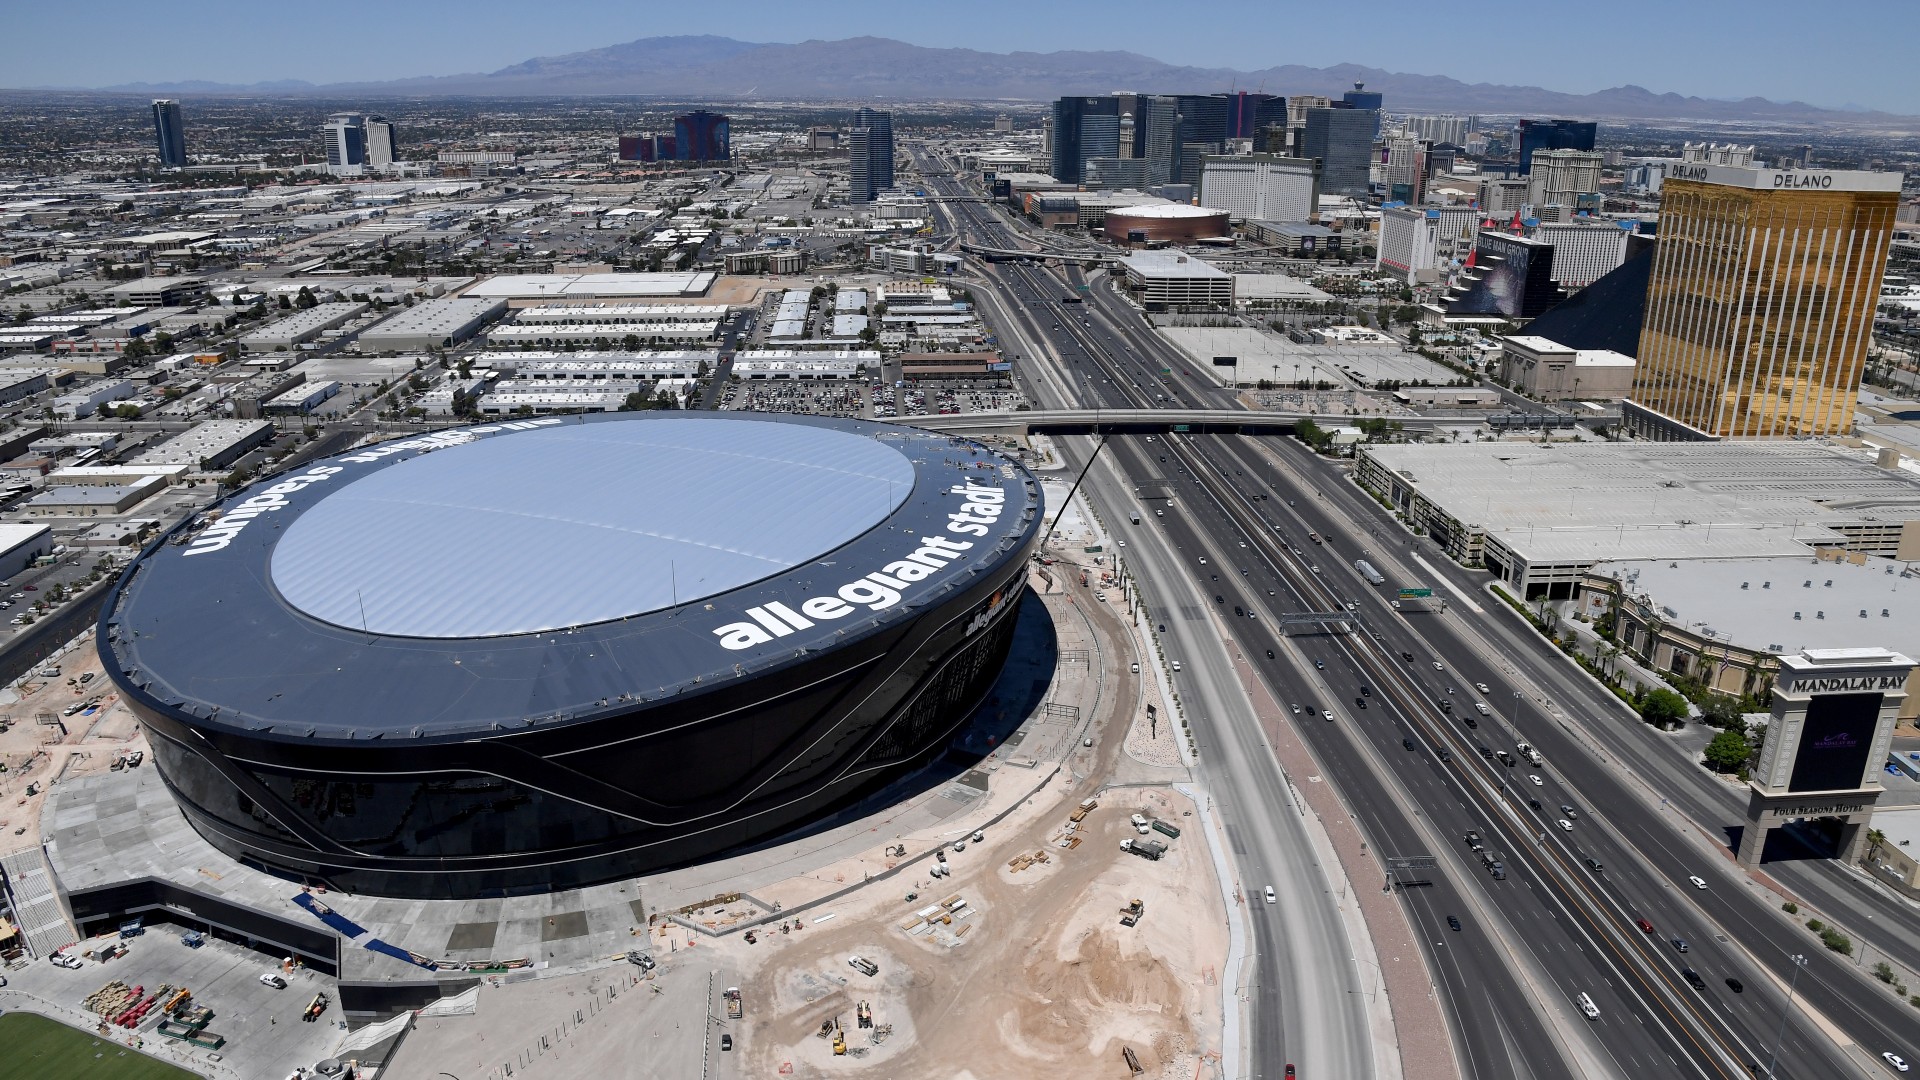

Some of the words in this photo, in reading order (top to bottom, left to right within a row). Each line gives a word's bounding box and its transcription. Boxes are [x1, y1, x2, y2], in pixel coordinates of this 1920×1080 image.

[1672, 164, 1708, 180] DELANO
[1773, 173, 1832, 188] DELANO
[1477, 236, 1493, 250] BLUE
[1492, 239, 1507, 254] MAN
[1506, 243, 1529, 258] GROUP
[712, 536, 974, 651] allegiant
[1792, 677, 1878, 694] MANDALAY
[1878, 676, 1907, 690] BAY
[1772, 806, 1798, 817] FOUR
[1797, 805, 1834, 815] SEASONS
[1834, 803, 1864, 813] HOTEL
